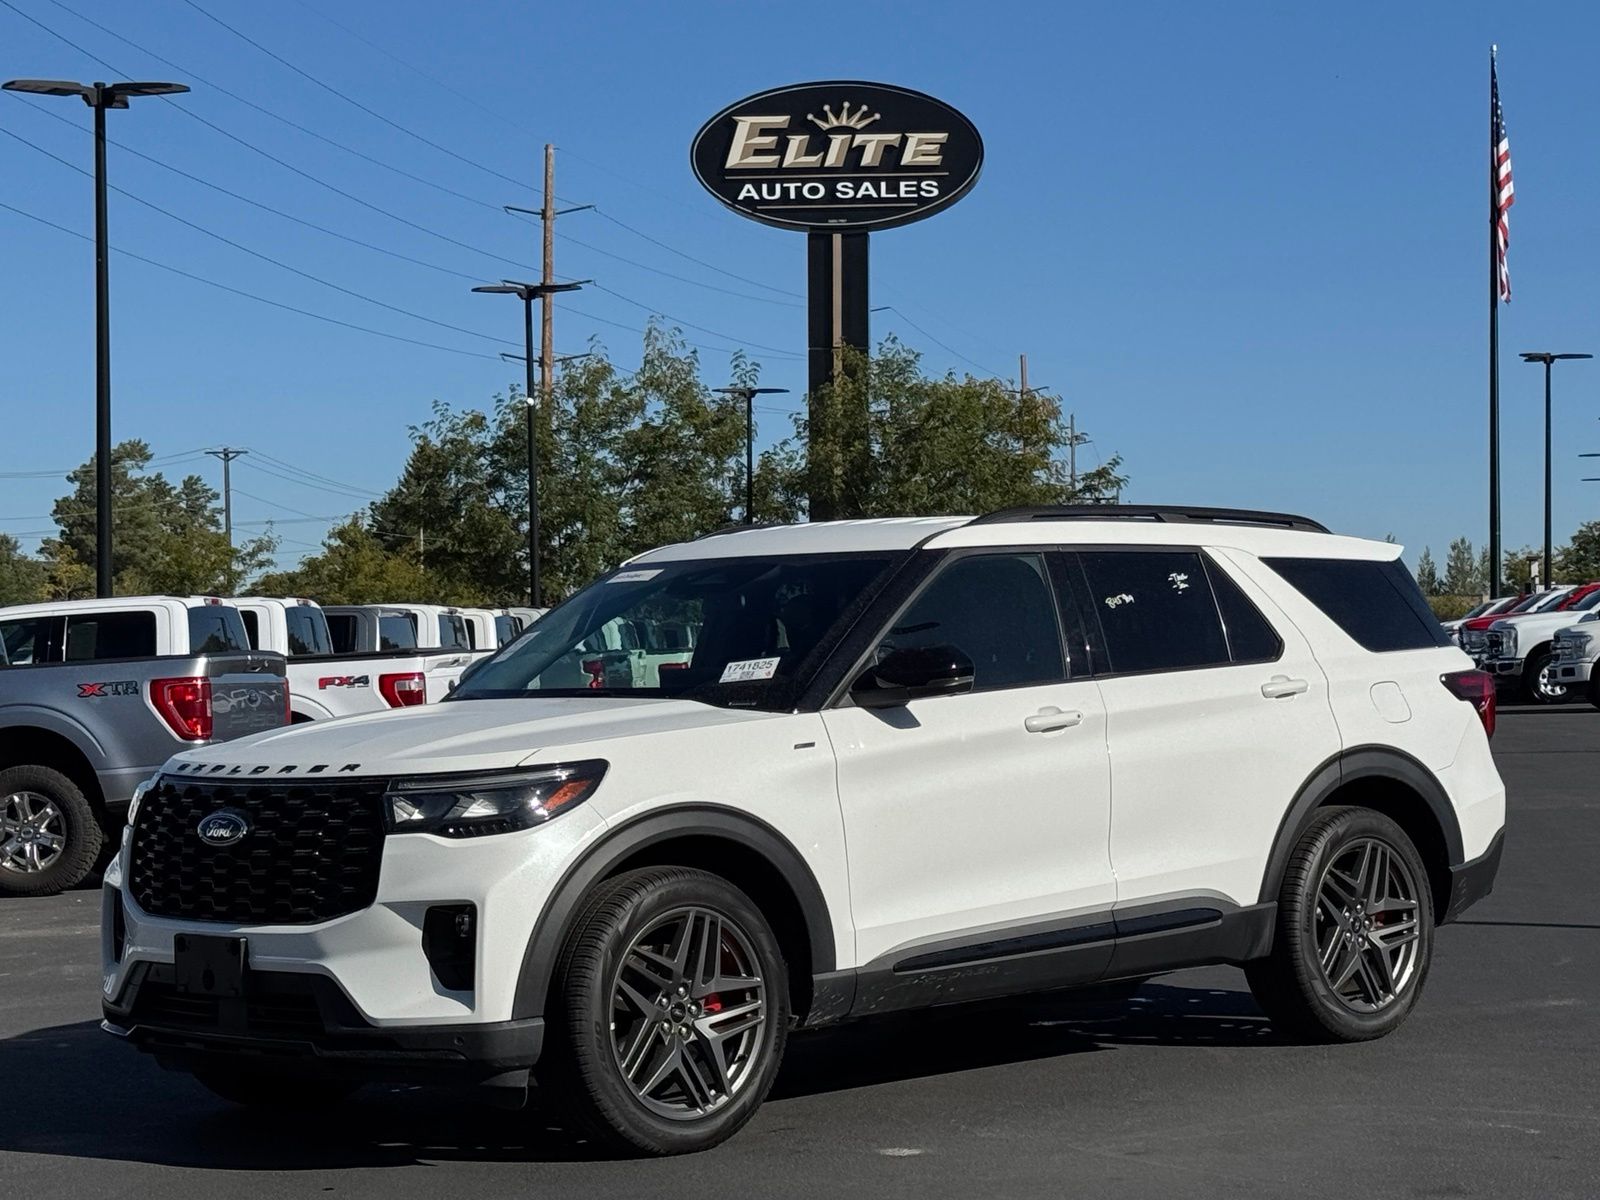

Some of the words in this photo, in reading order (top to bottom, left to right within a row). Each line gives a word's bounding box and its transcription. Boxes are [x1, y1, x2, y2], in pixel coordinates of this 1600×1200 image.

[724, 115, 949, 169] ELITE
[737, 182, 826, 200] AUTO
[835, 180, 940, 198] SALES
[727, 660, 774, 673] 1741825
[76, 680, 139, 698] XTR
[318, 674, 370, 690] FX4
